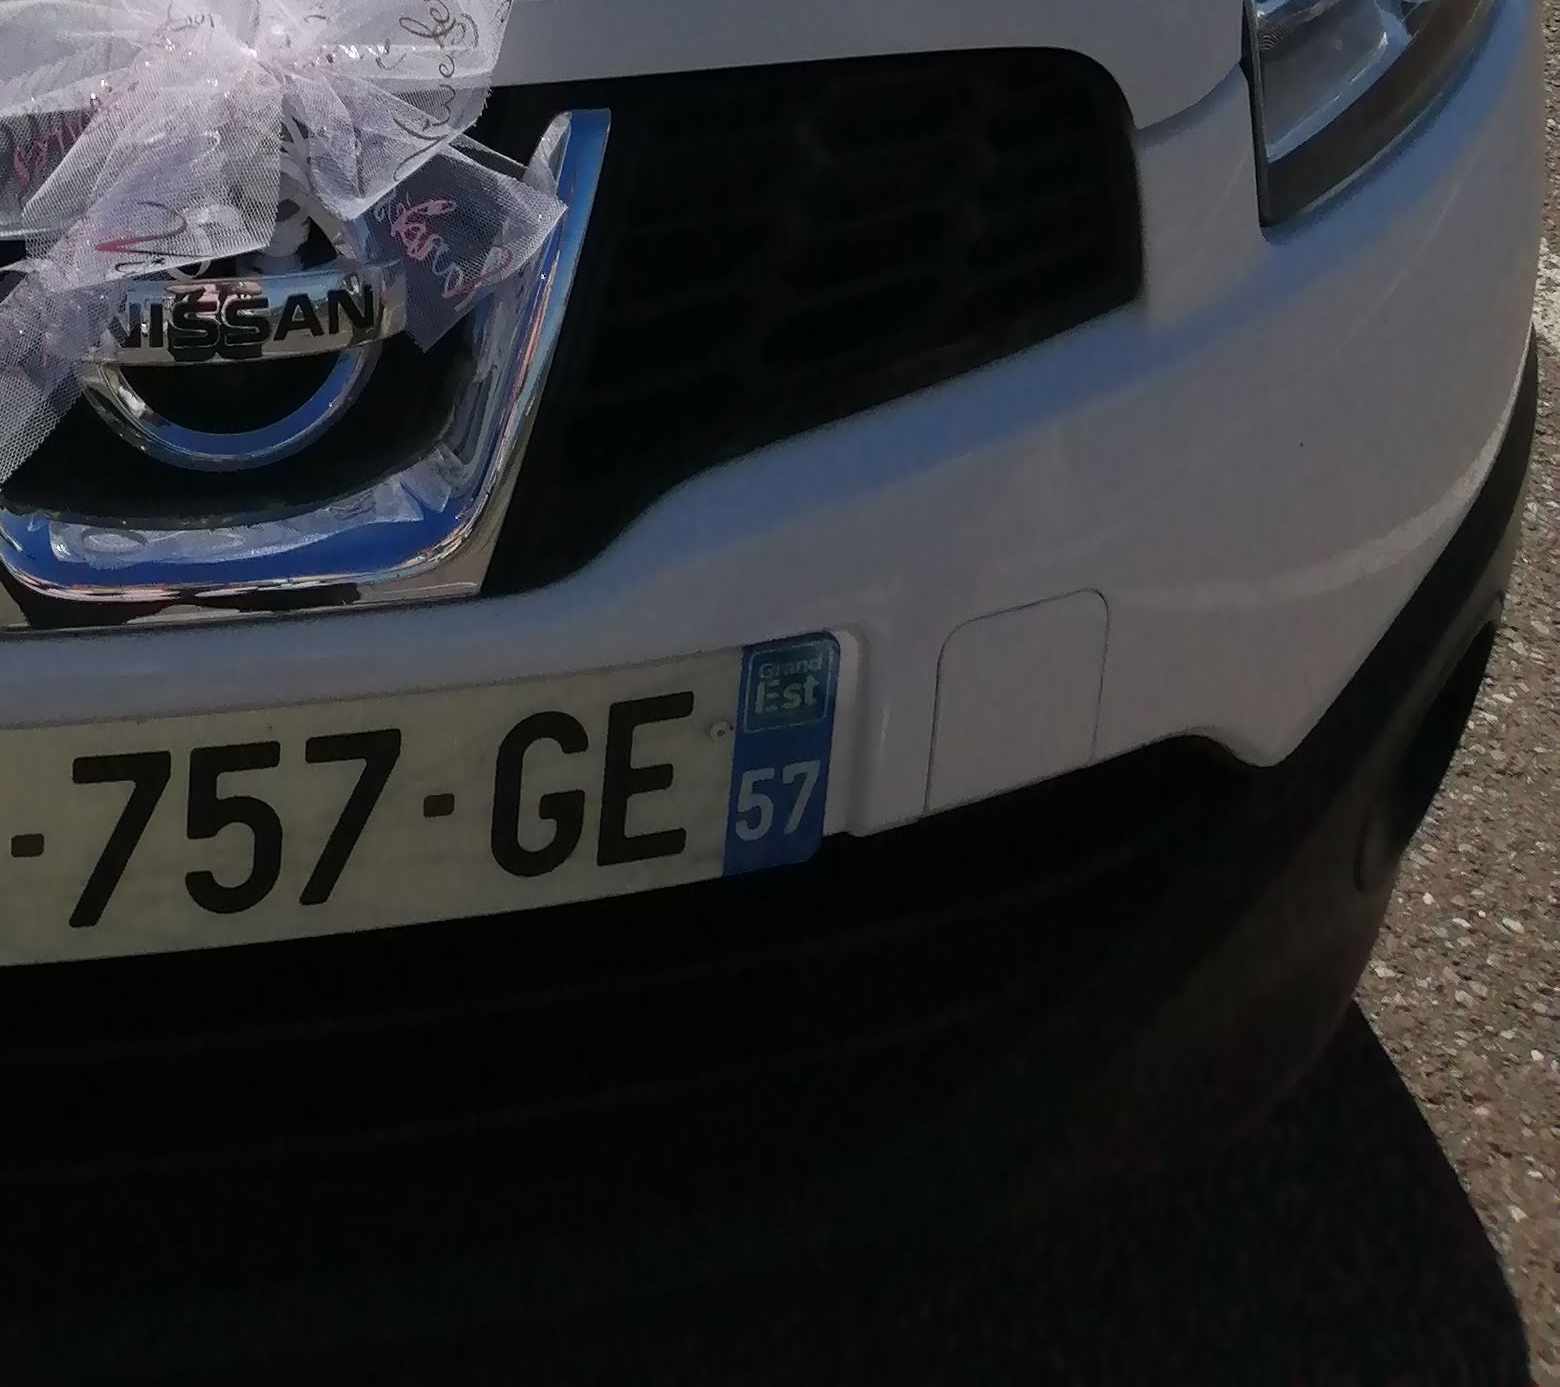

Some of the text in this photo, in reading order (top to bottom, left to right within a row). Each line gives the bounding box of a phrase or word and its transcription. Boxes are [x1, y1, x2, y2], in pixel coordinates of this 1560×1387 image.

[117, 279, 378, 350] NISSAN
[754, 674, 820, 715] Est
[758, 654, 822, 679] Grand
[735, 758, 822, 843] 57
